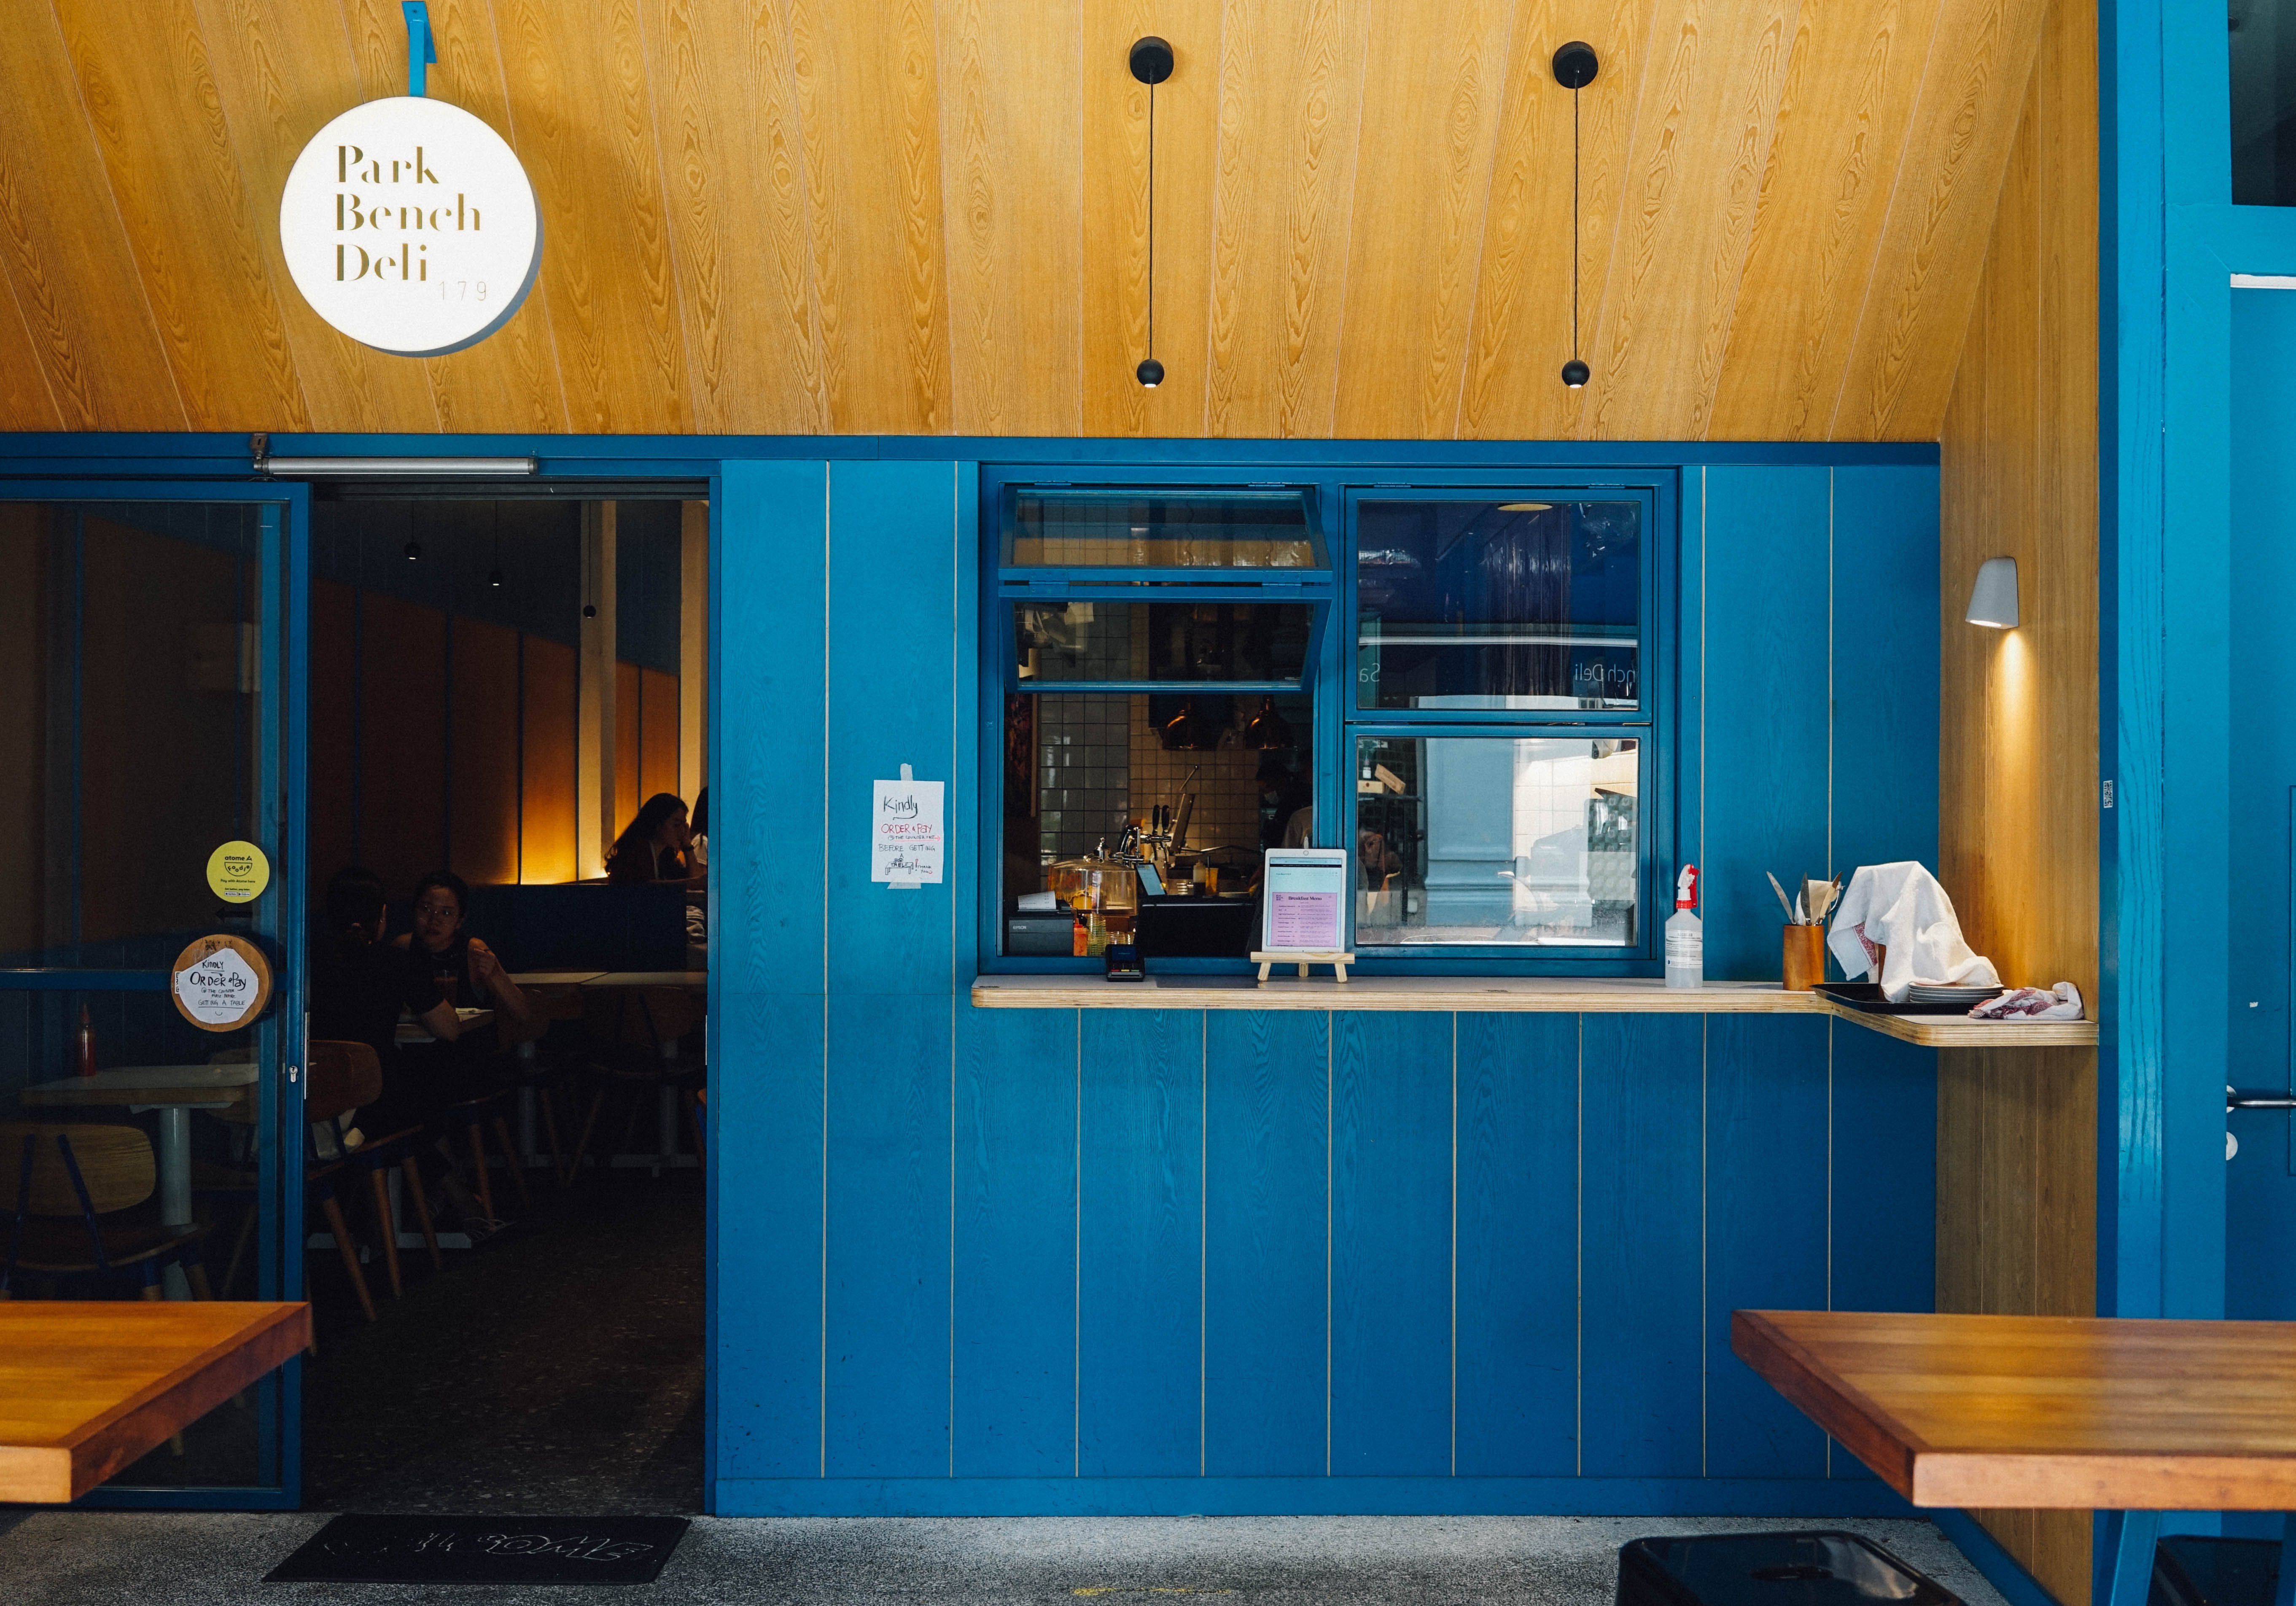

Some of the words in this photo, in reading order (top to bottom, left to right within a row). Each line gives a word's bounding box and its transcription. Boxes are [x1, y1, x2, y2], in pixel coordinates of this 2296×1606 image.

[334, 145, 439, 184] Park
[333, 193, 480, 231] Bench
[332, 243, 427, 281] Deli
[439, 281, 486, 301] 179
[883, 795, 918, 820] Kindly
[881, 823, 911, 834] ORDER
[878, 844, 904, 852] BEFORE
